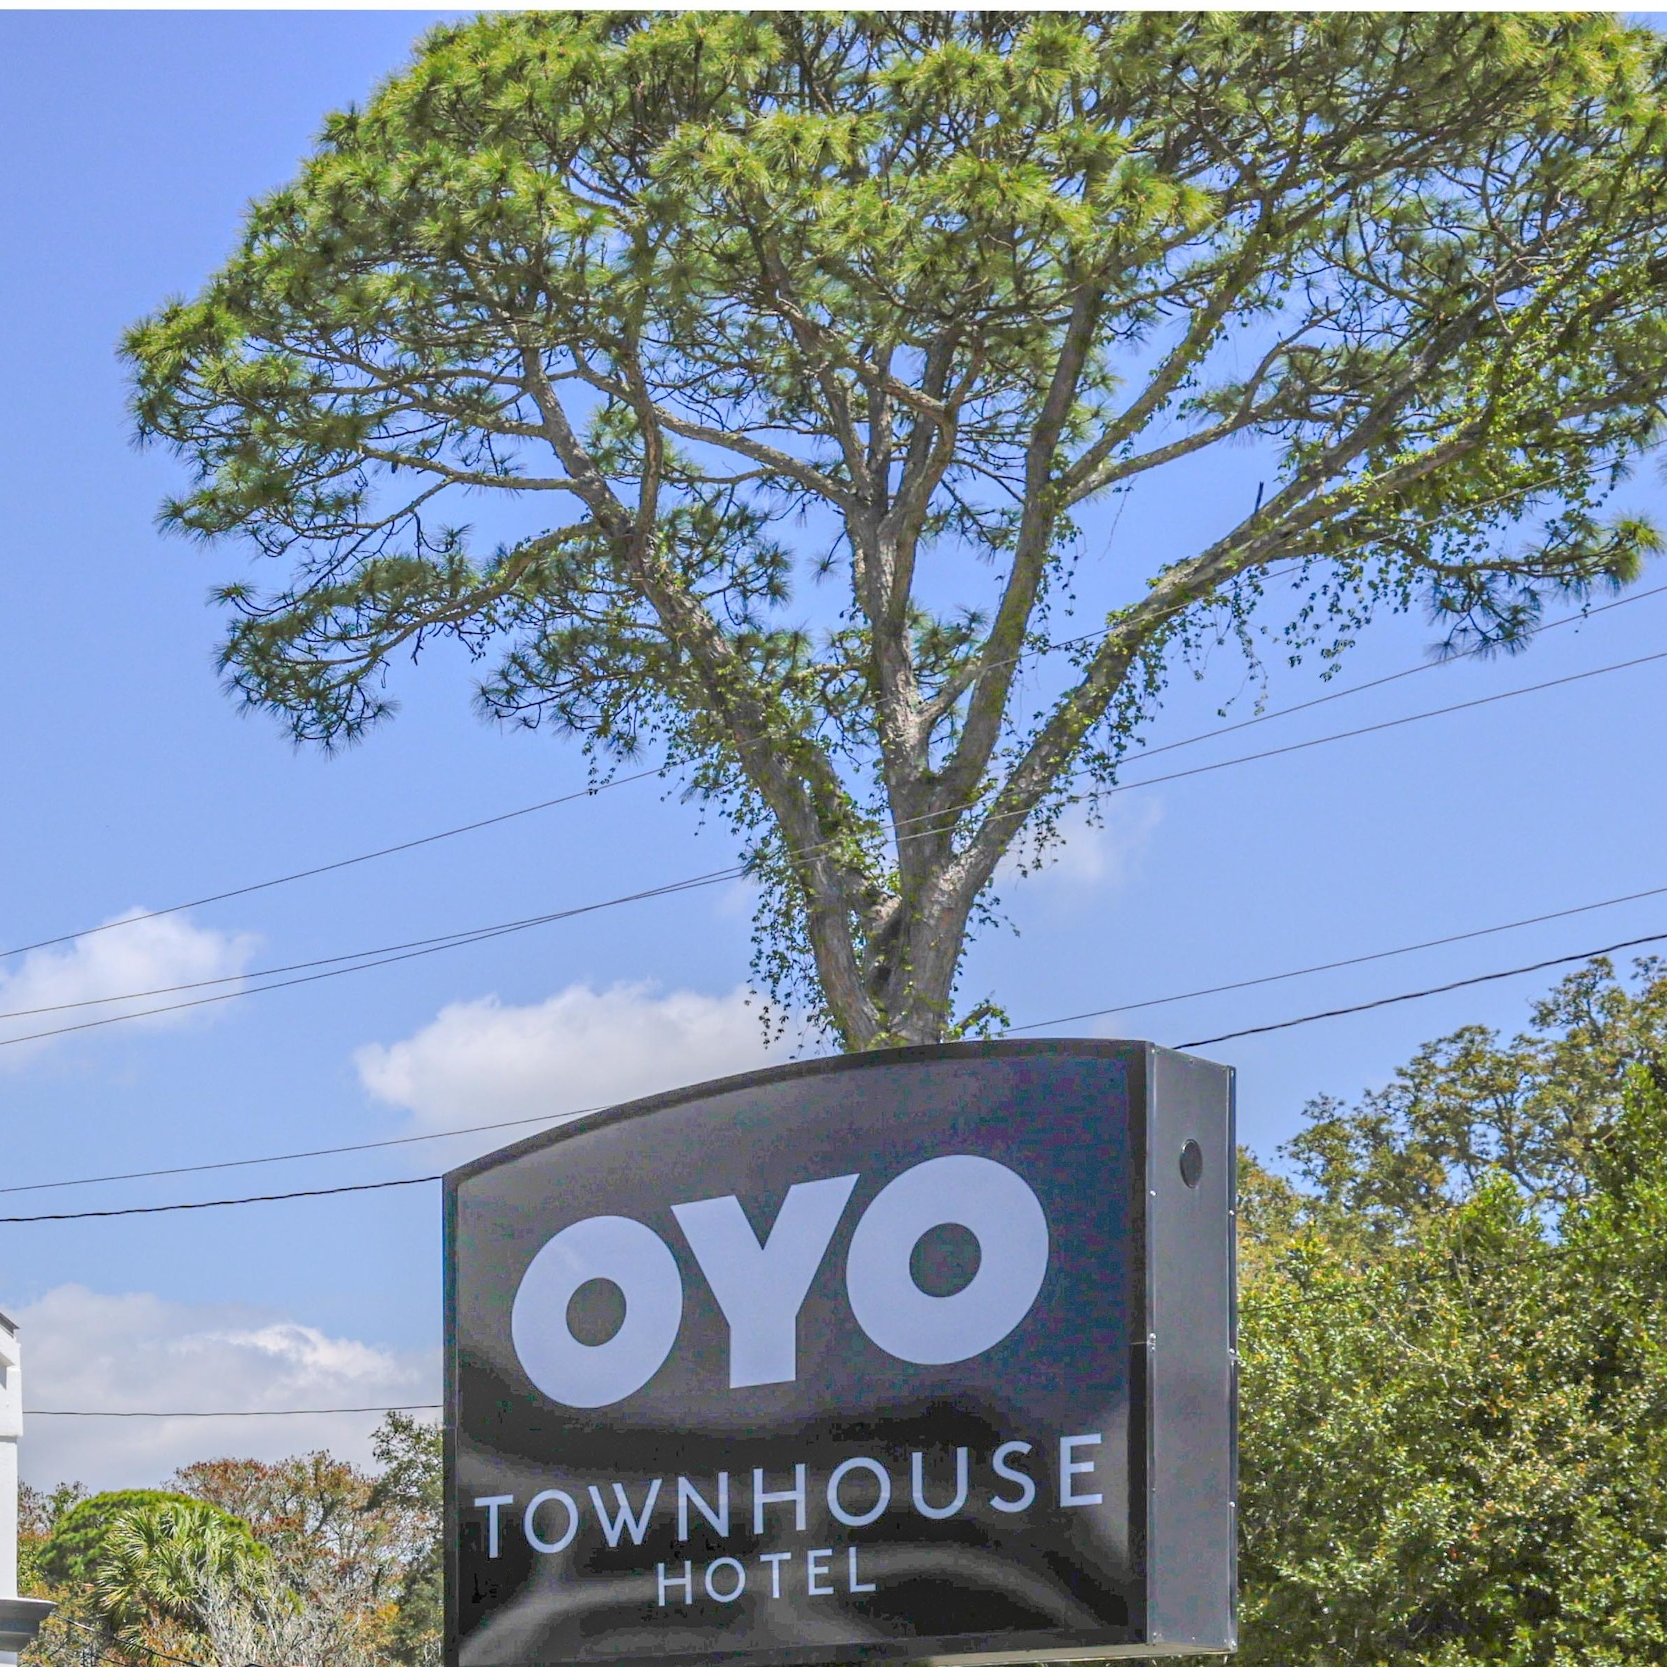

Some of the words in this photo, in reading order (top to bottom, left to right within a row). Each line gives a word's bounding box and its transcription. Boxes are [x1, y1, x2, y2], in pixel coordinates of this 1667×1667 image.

[512, 1154, 1049, 1408] OYO
[475, 1433, 1103, 1558] TOWNHOUSE
[658, 1547, 876, 1607] HOTEL
